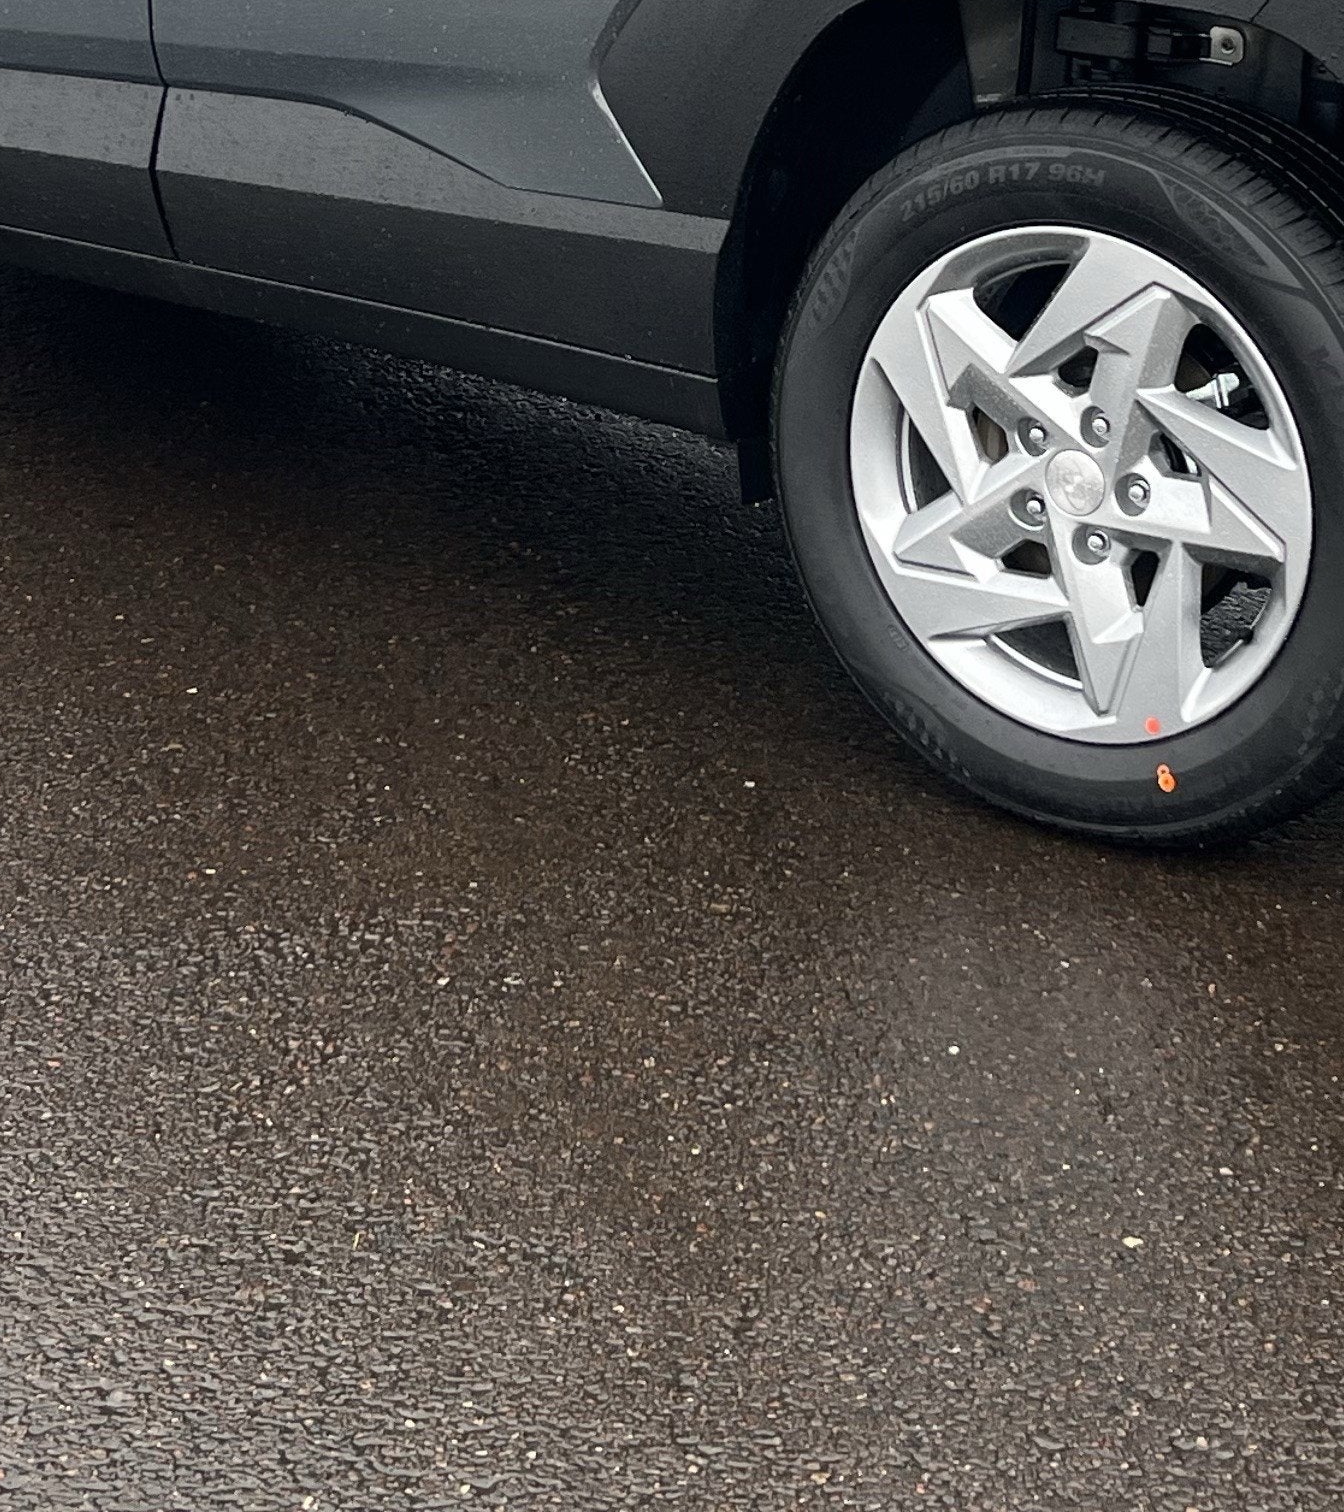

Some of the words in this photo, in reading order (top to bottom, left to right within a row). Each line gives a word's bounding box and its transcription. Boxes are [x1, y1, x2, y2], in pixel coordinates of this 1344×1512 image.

[899, 168, 981, 222] 215/60
[988, 161, 1043, 185] R17
[1047, 162, 1107, 187] 96H
